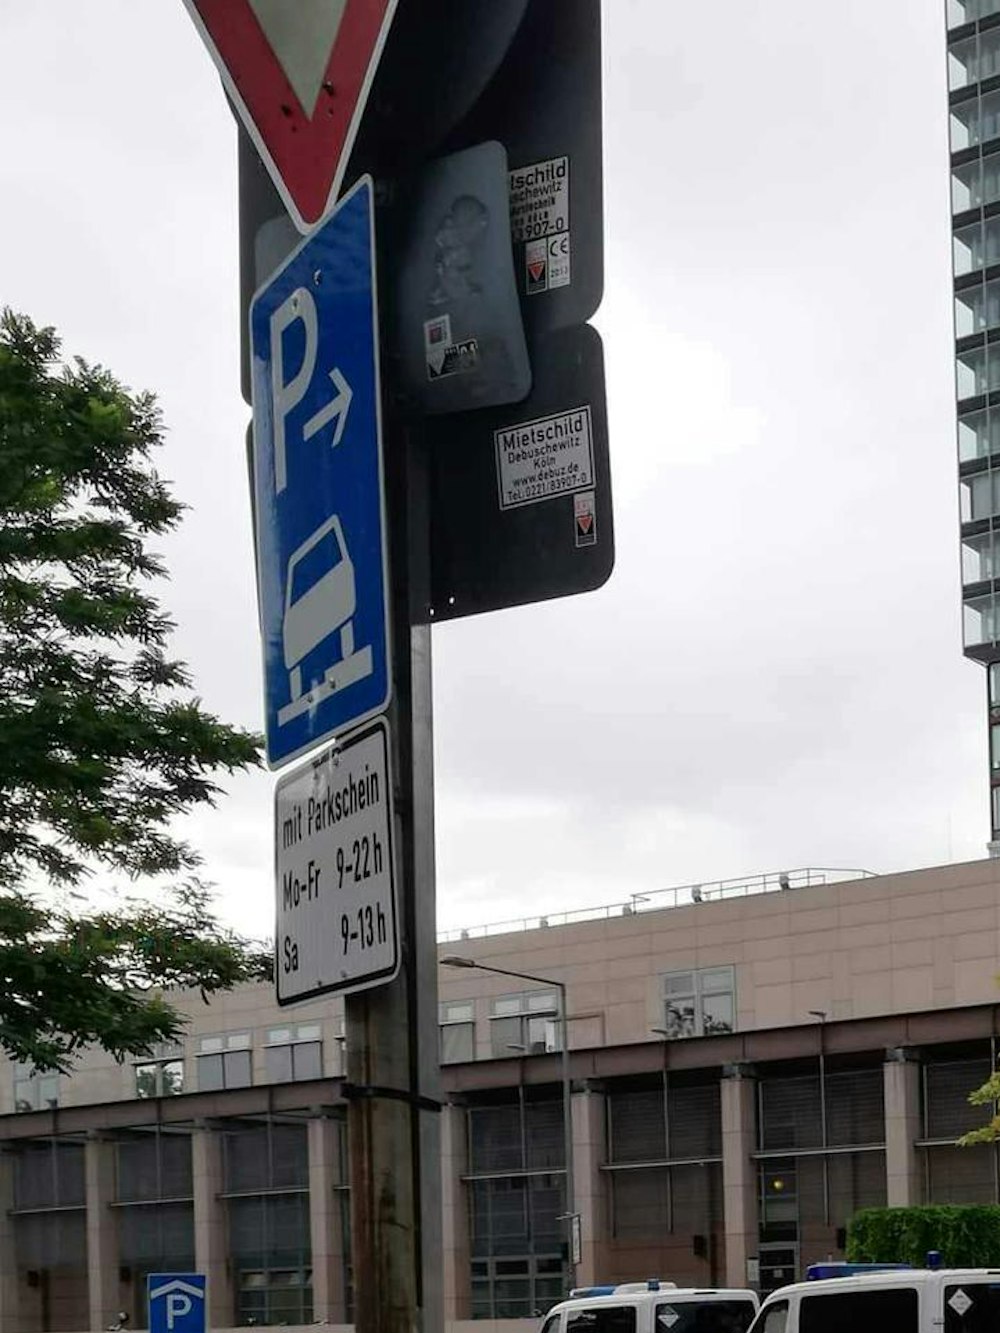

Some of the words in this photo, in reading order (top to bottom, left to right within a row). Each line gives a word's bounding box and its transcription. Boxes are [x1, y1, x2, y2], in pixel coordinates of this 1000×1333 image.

[269, 287, 318, 494] P
[503, 415, 583, 452] Mietschild
[508, 437, 580, 463] Debuschewitz
[283, 801, 302, 850] mit
[308, 764, 380, 836] Parkschein
[283, 860, 321, 912] Mo-Fr
[284, 935, 299, 974] Sa
[167, 1294, 192, 1329] P
